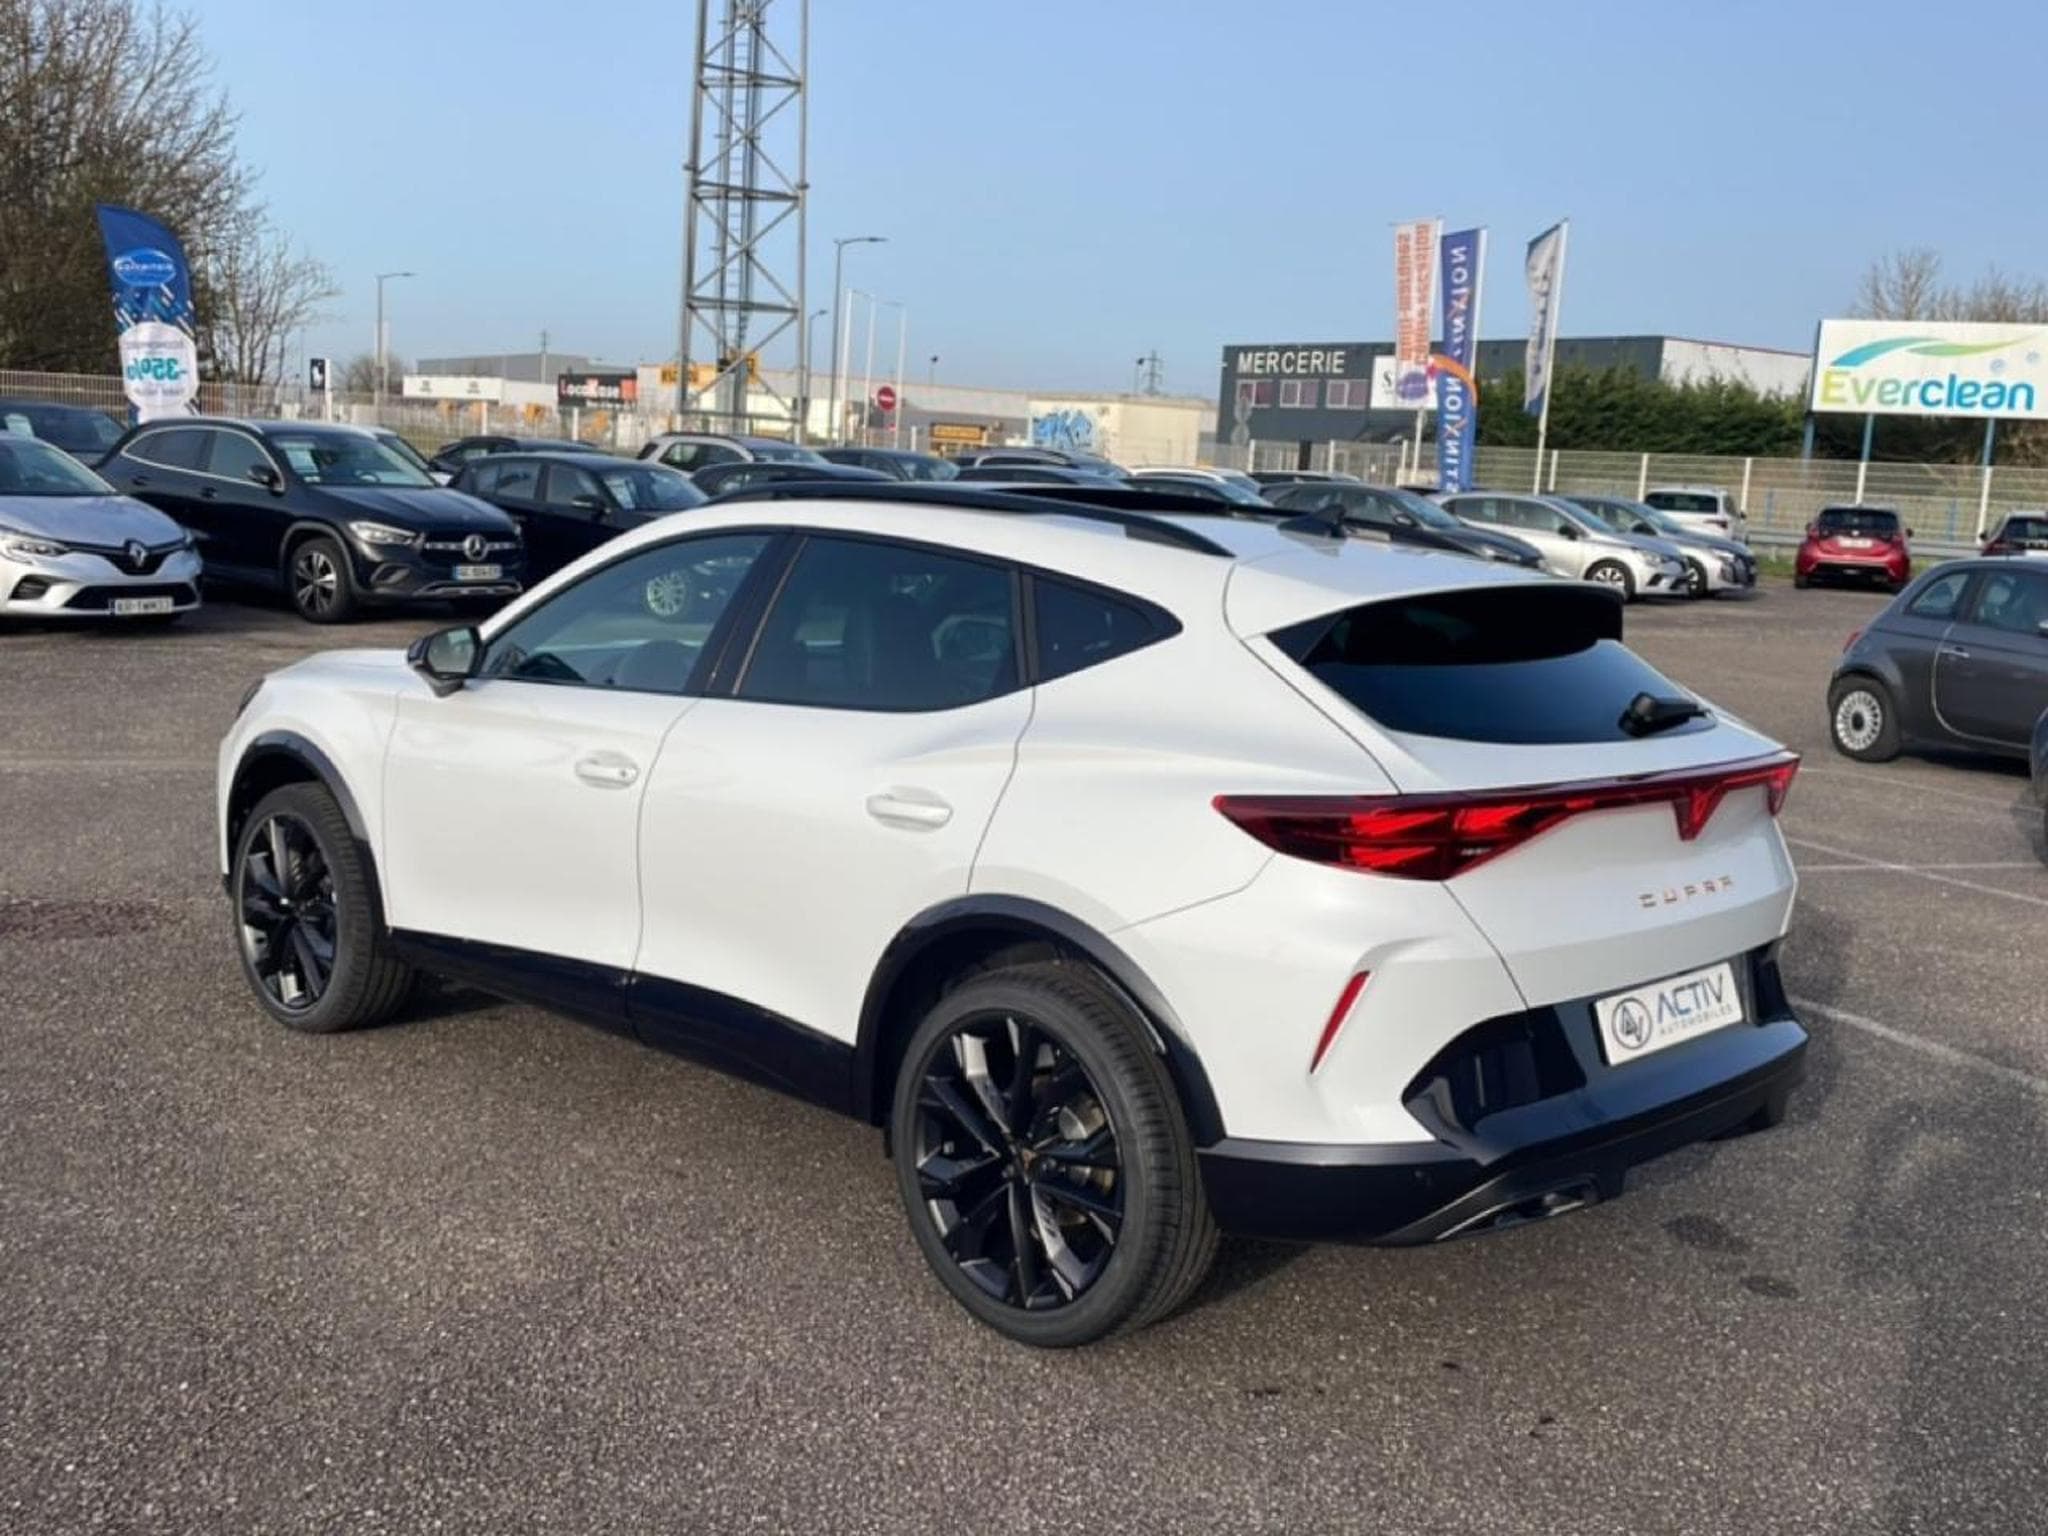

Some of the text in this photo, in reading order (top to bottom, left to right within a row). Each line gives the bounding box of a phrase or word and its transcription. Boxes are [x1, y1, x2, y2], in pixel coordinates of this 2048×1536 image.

[1237, 351, 1344, 373] MERCERIE
[1821, 370, 2035, 410] Everclean
[1639, 876, 1733, 907] CUPRA
[1657, 973, 1723, 1024] ACTIV
